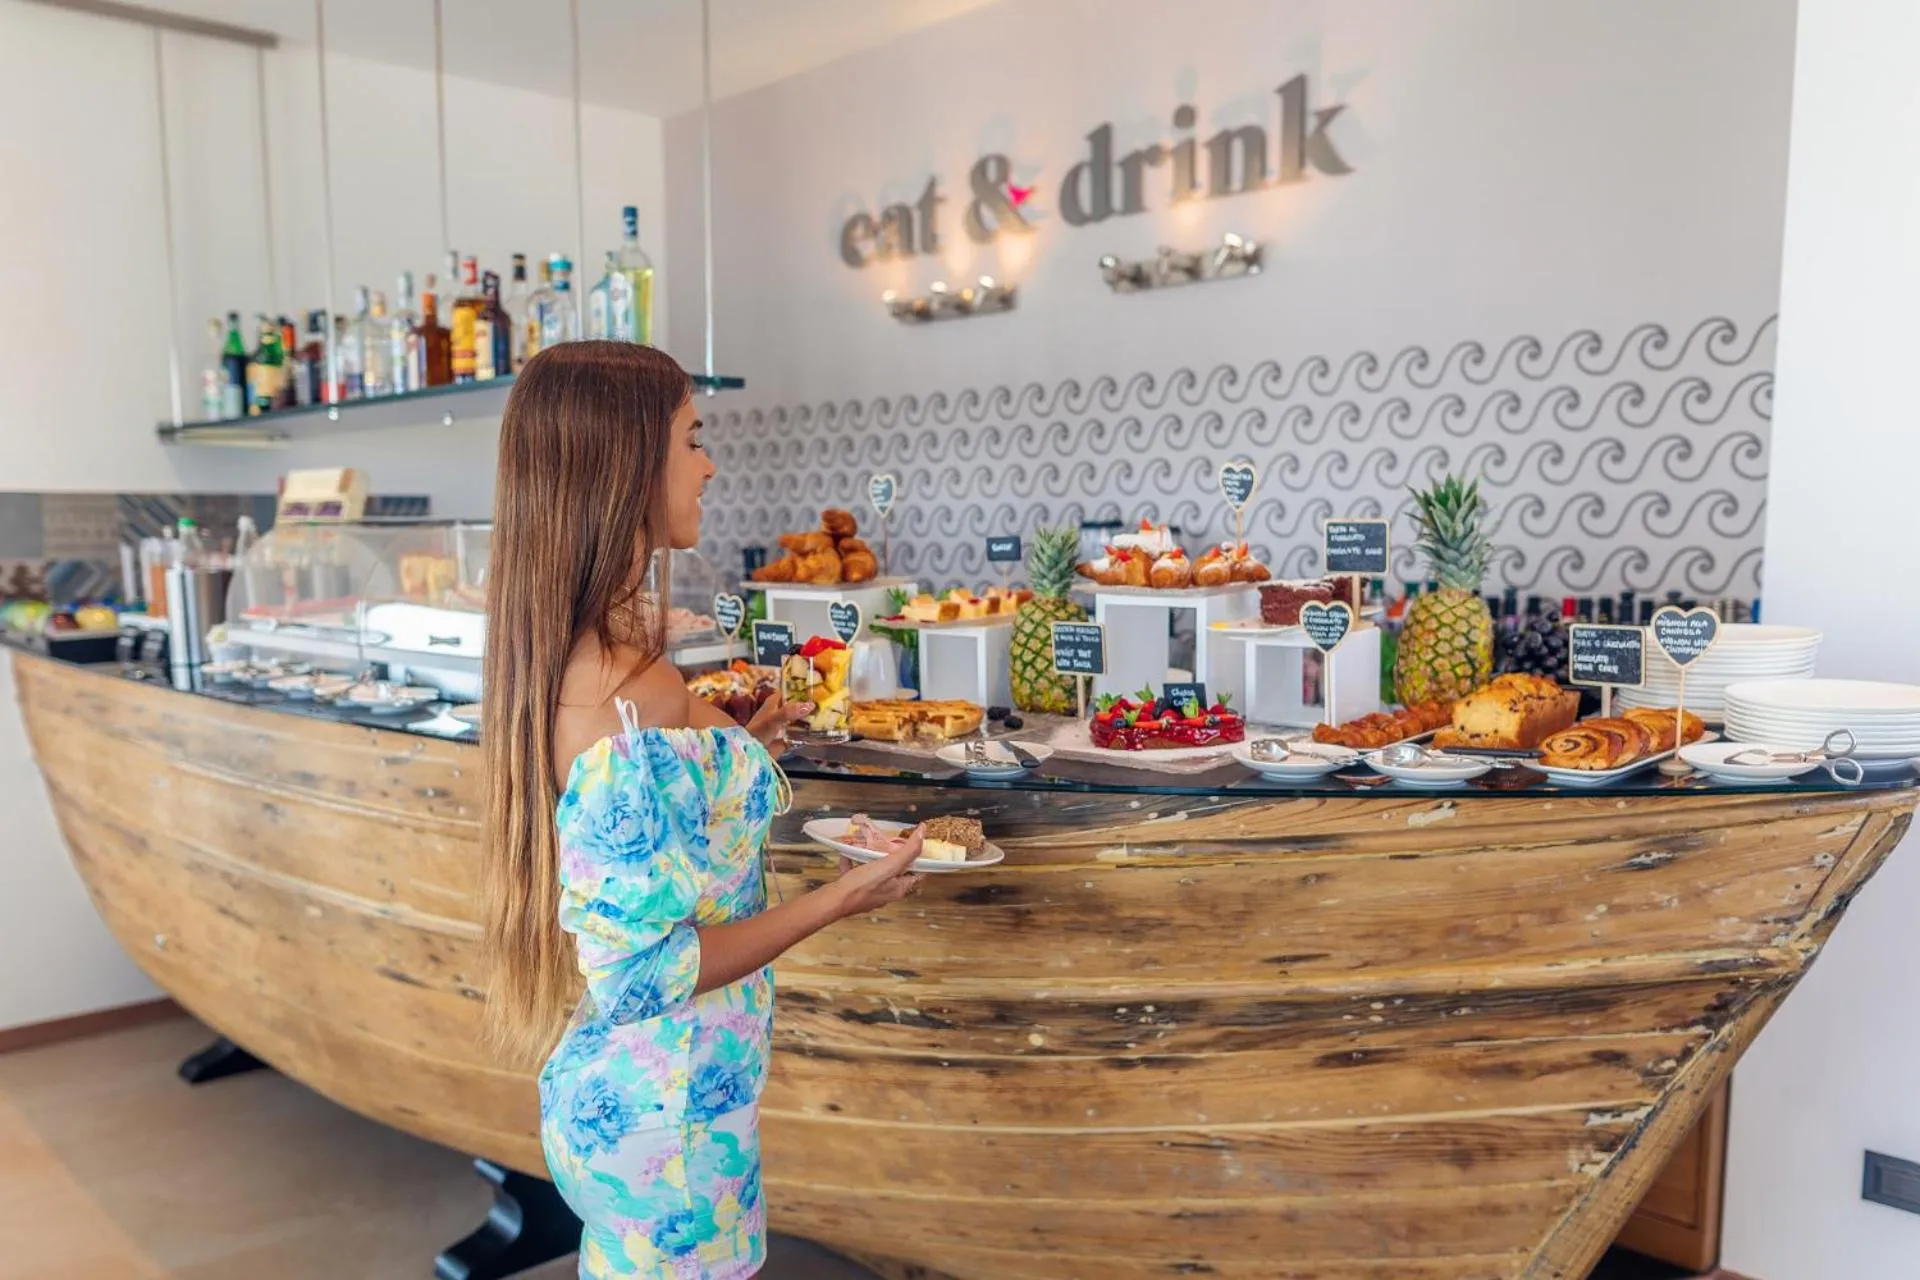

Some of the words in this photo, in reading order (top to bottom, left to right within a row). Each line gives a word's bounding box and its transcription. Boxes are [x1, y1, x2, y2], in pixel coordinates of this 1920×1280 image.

[840, 174, 945, 269] eat
[964, 153, 1037, 245] &
[1059, 73, 1357, 227] drink
